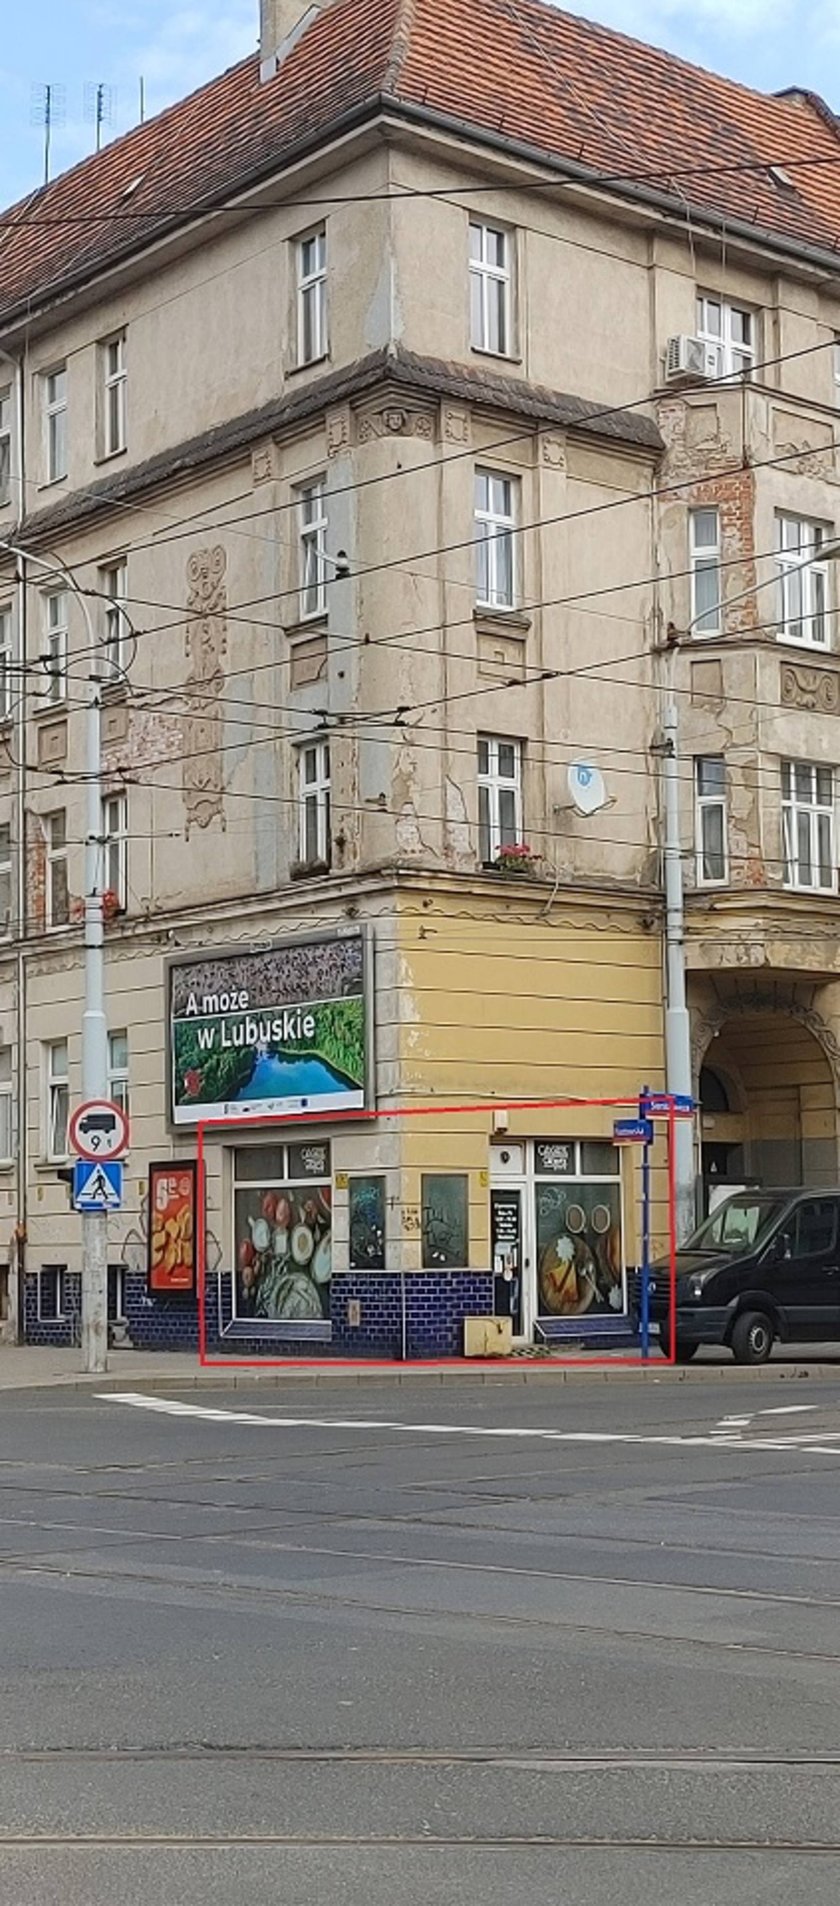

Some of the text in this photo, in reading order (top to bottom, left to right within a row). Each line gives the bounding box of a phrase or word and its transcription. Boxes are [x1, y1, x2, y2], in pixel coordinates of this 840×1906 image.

[186, 986, 249, 1016] A może
[198, 1009, 315, 1049] w Lubuskie
[91, 1135, 101, 1151] 9
